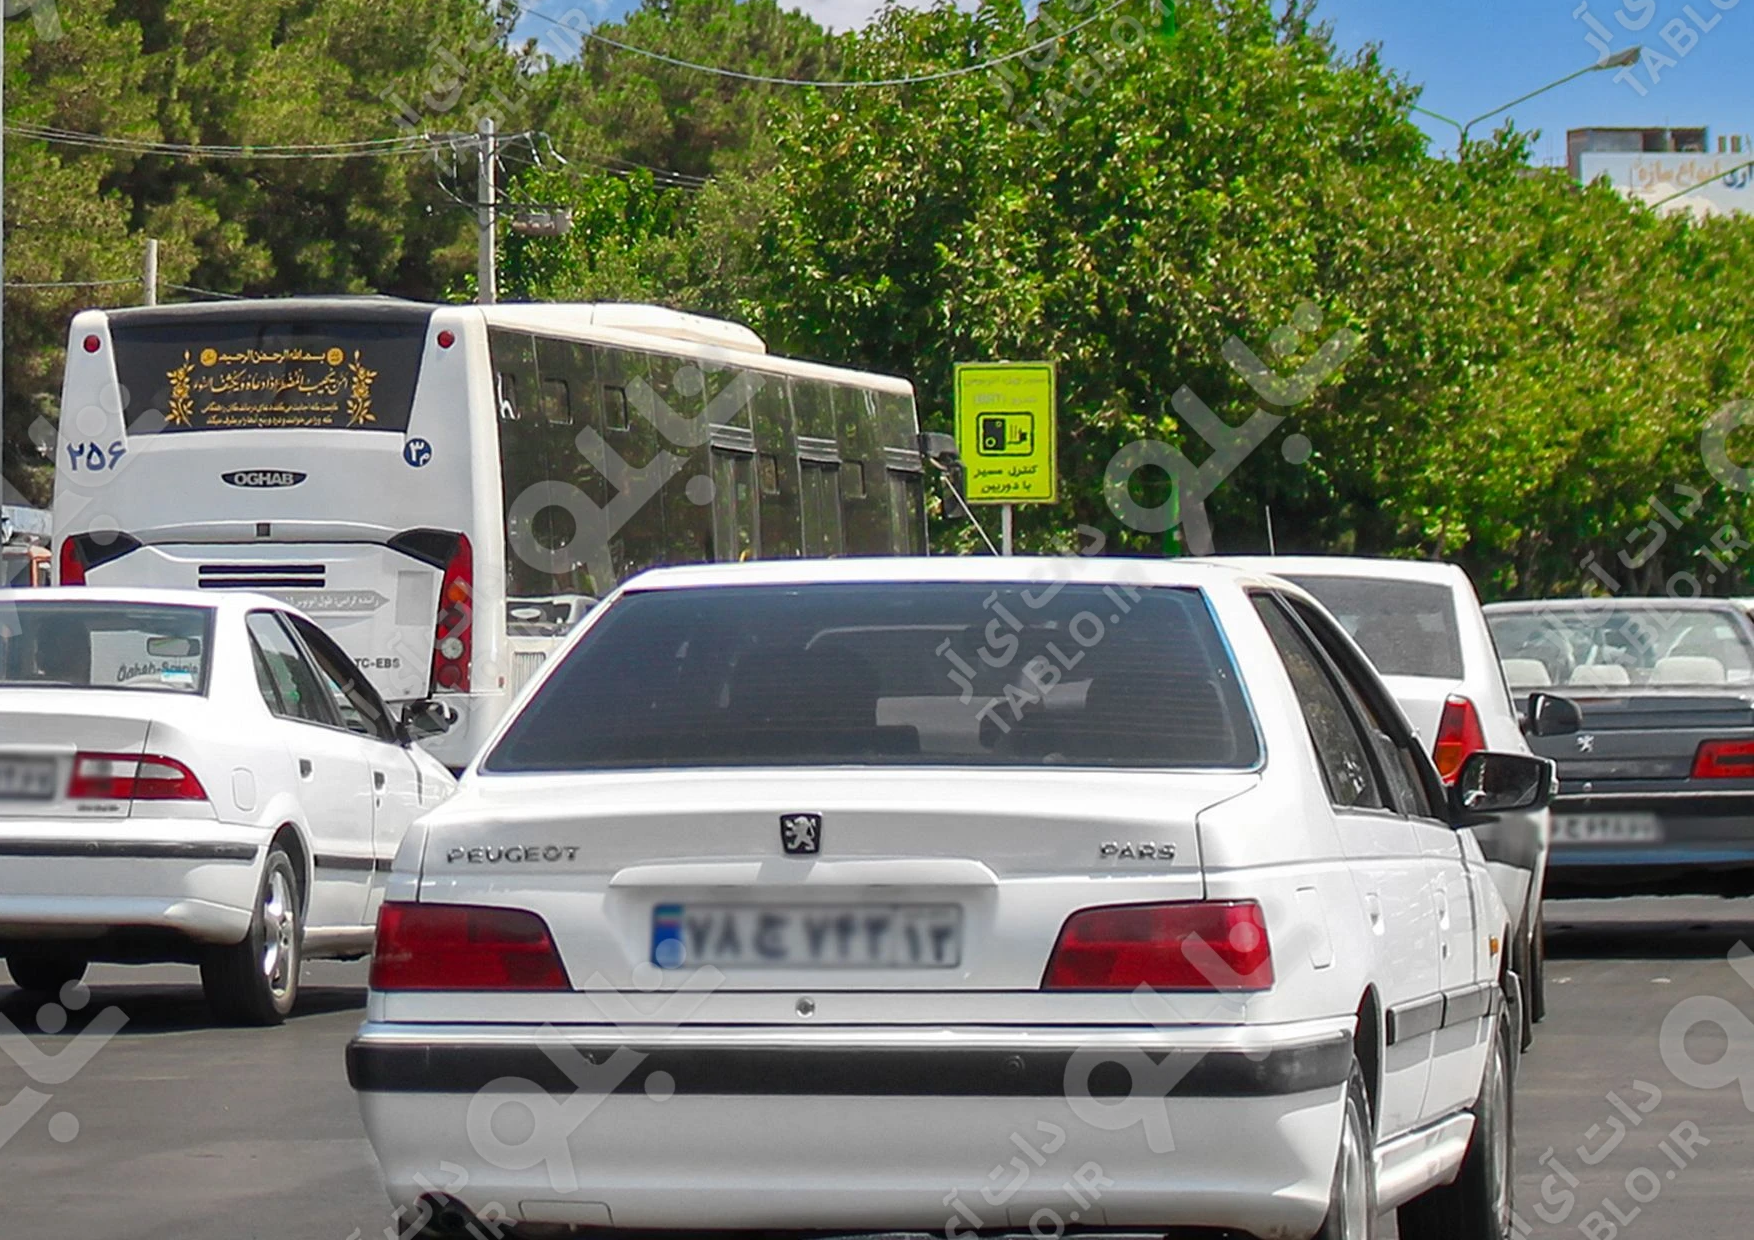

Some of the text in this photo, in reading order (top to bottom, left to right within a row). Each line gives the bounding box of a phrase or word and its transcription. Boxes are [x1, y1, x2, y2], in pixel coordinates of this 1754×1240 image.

[66, 440, 128, 472] ۲۵۶
[234, 472, 294, 486] OGHAB
[446, 844, 581, 864] PEUGEOT
[1098, 840, 1178, 862] PARS
